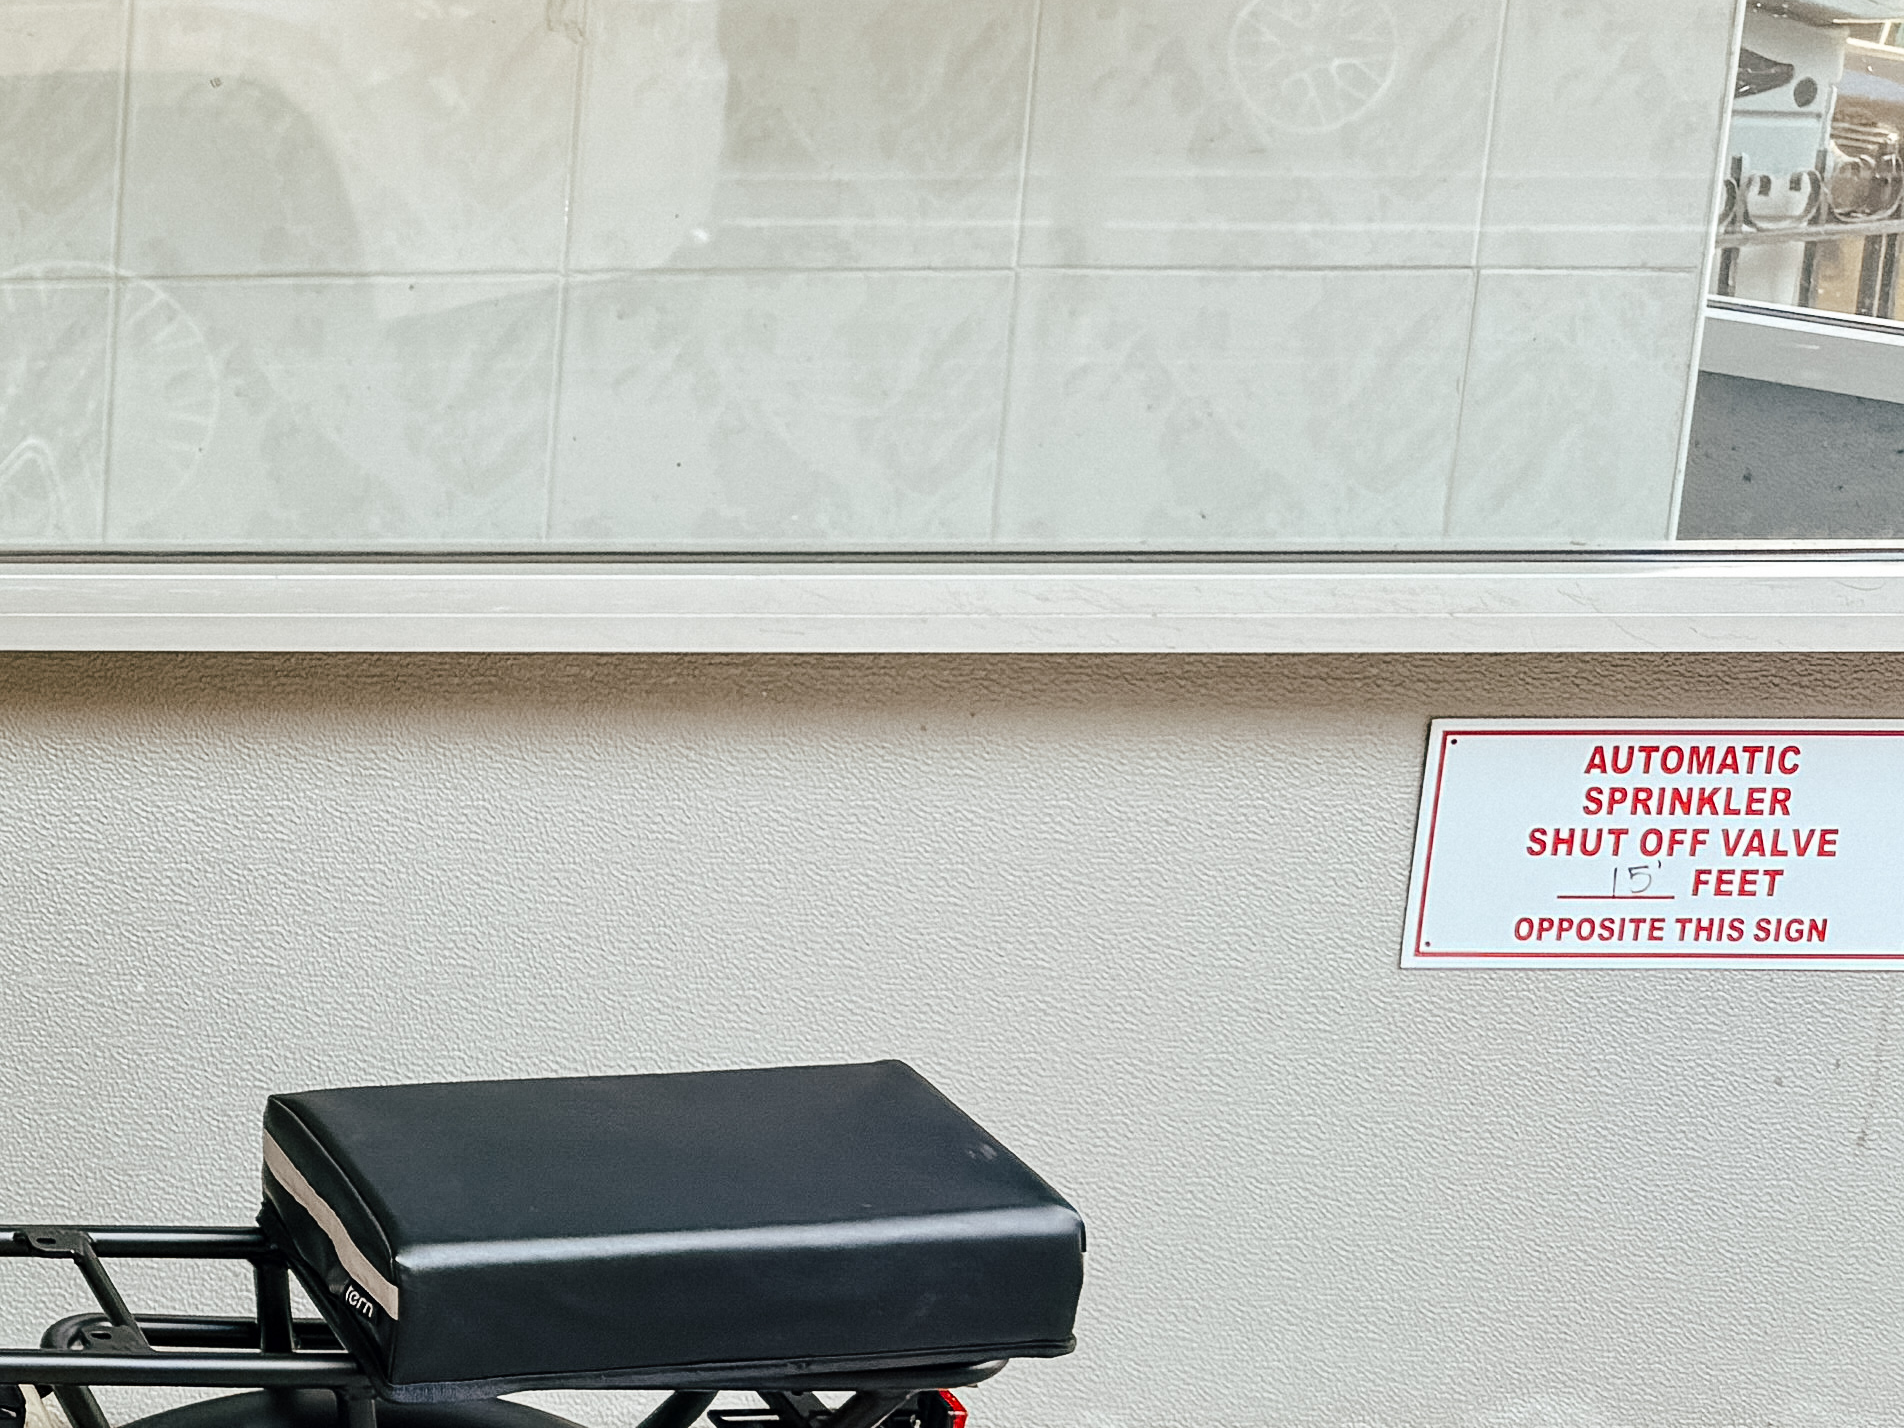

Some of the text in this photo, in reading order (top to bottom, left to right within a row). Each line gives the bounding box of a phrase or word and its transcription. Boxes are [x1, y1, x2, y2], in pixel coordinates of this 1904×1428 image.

[1584, 745, 1801, 775] AUTOMATIC
[1583, 786, 1792, 816] SPRINKLER
[1526, 828, 1839, 857] SHUT OFF VALVE
[1691, 869, 1784, 897] FEET
[1514, 917, 1828, 942] OPPOSITE THIS SIGN
[345, 1283, 375, 1320] tern
